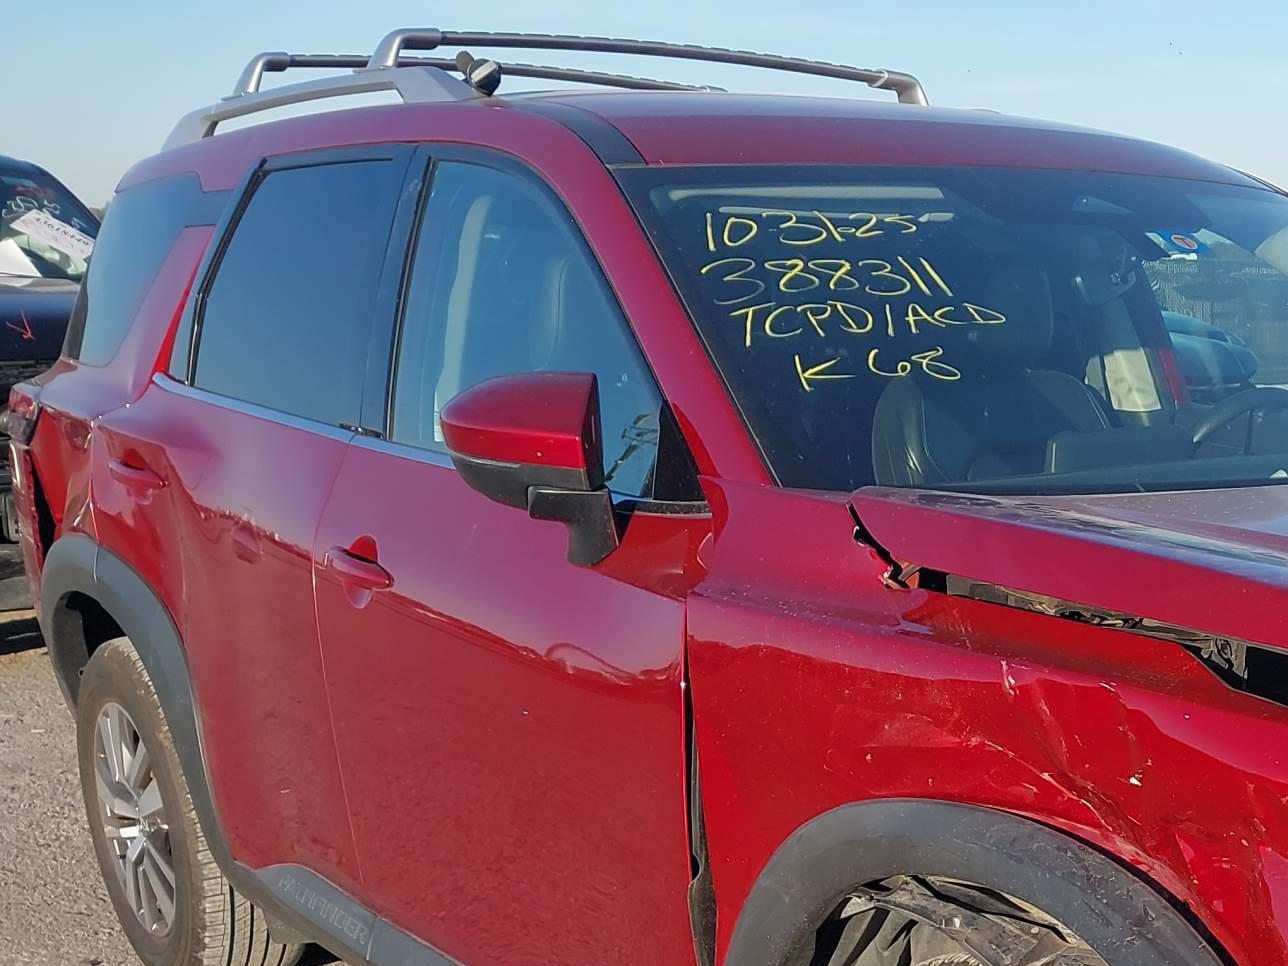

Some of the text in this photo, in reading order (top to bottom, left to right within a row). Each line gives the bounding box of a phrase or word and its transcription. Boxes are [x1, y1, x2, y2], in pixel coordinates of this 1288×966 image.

[700, 255, 954, 305] 388311
[794, 346, 961, 392] K 68
